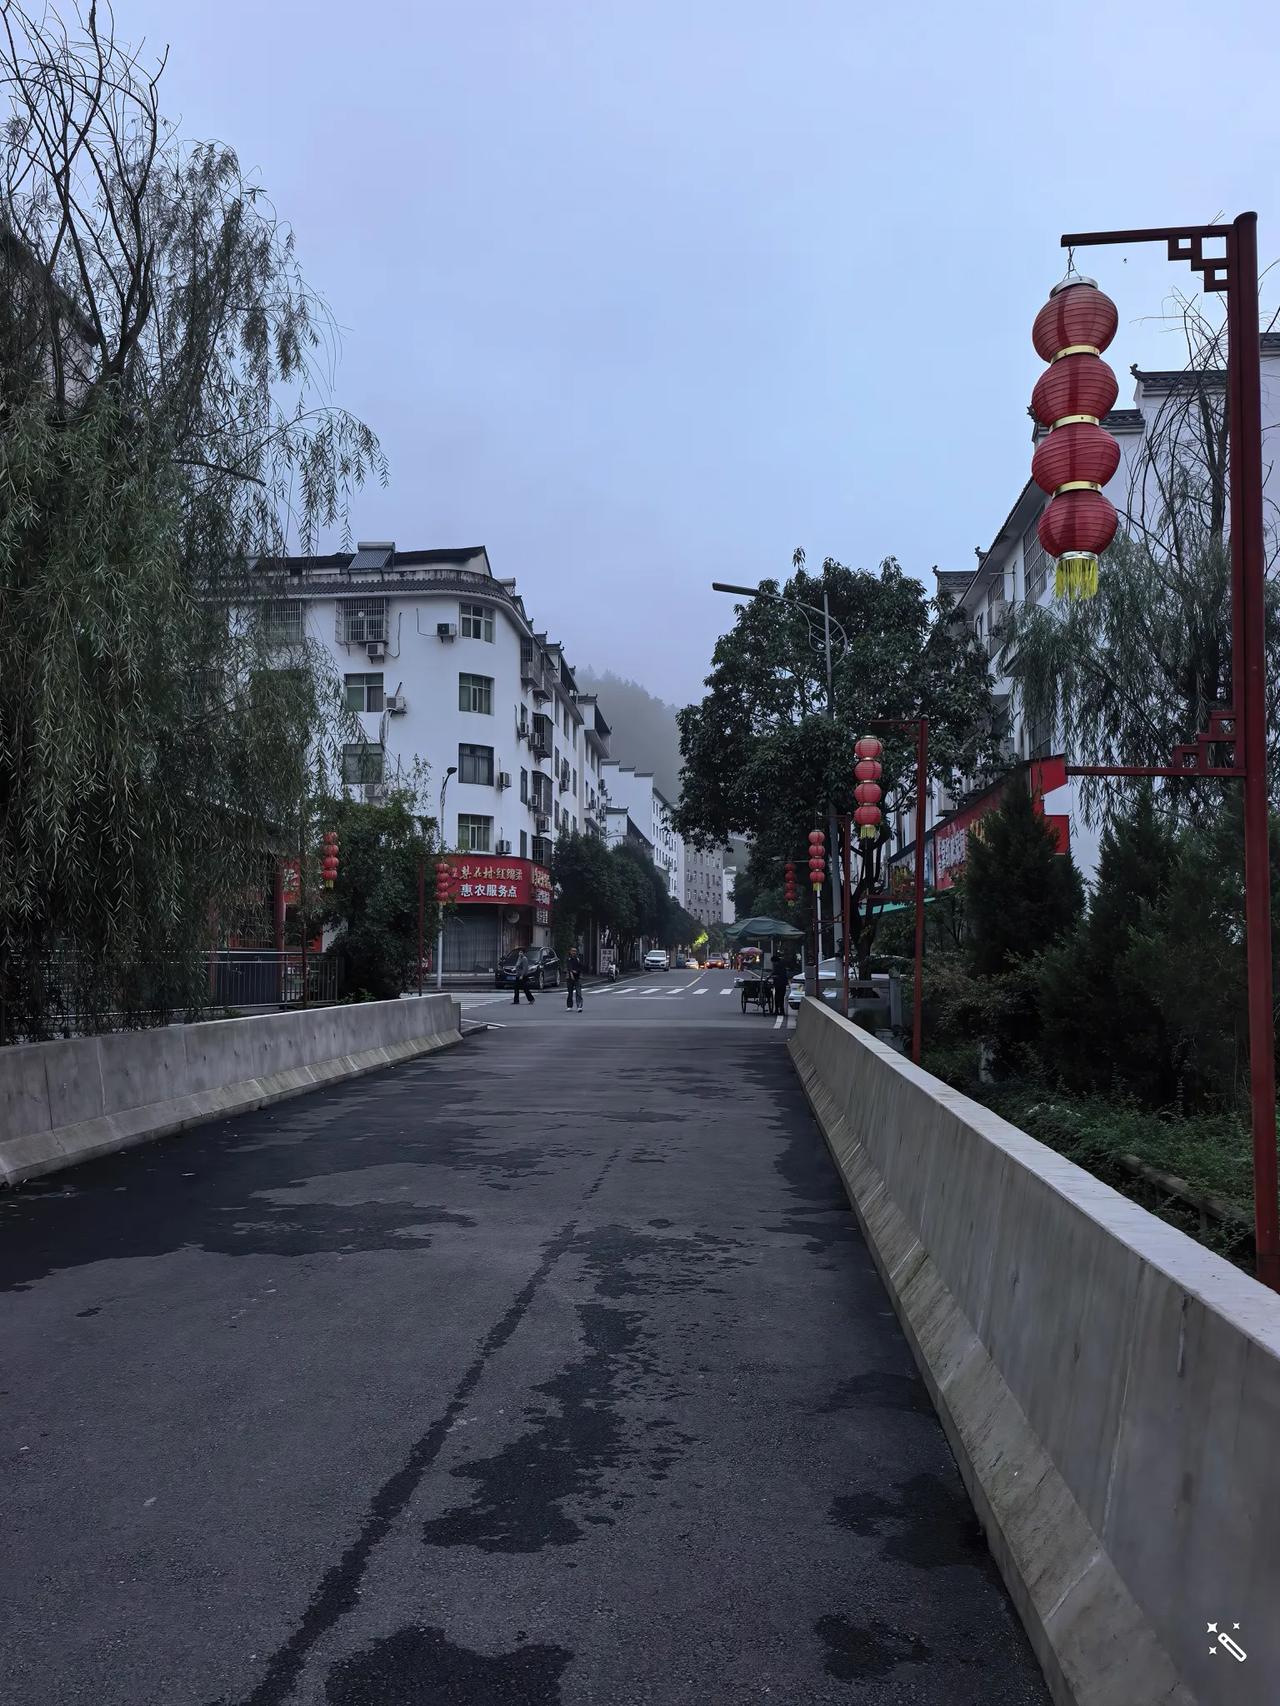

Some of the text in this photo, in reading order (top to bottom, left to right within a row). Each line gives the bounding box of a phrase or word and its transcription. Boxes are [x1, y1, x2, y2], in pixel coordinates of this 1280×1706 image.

[460, 883, 517, 897] 惠农服务点
